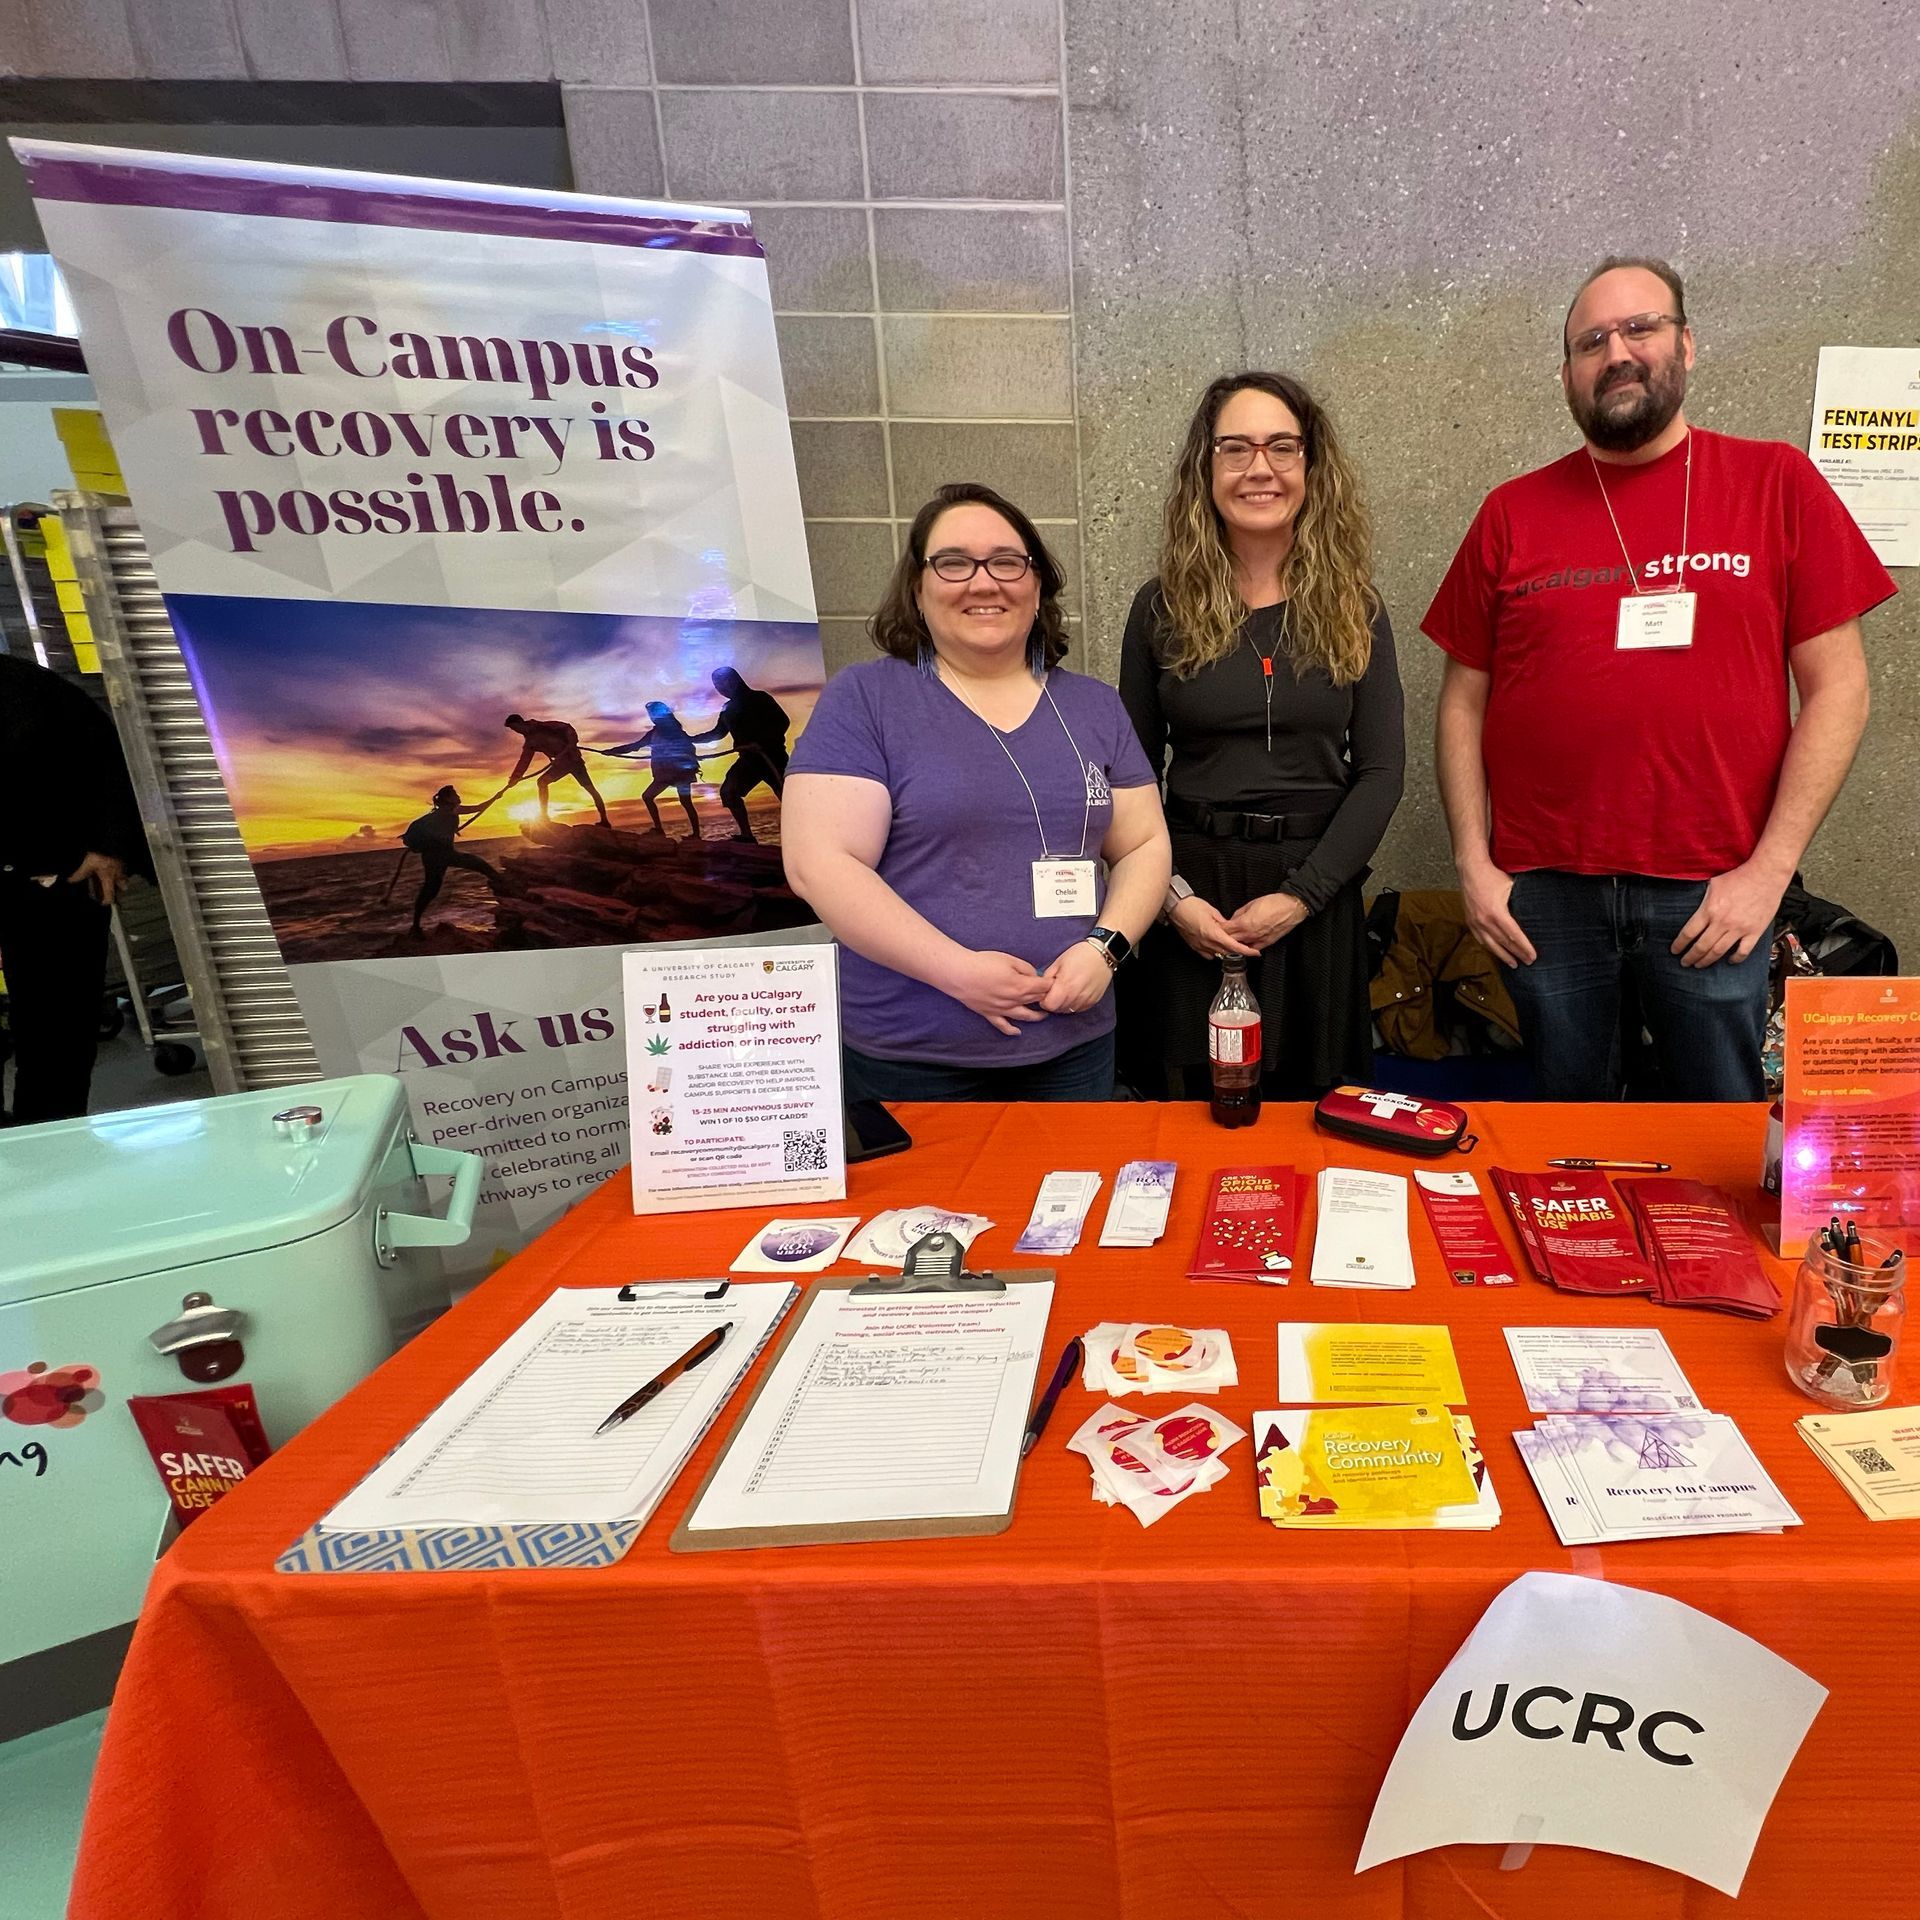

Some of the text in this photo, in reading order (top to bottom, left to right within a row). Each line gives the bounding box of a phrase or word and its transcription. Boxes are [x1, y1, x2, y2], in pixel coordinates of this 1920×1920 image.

[167, 307, 660, 401] On-Campus
[1823, 410, 1915, 427] FENTANYL
[189, 402, 655, 476] recovery is
[1822, 433, 1866, 449] TEST
[213, 472, 585, 552] possible.
[776, 964, 814, 972] CALGARY
[695, 994, 715, 1002] Are
[718, 994, 739, 1003] you
[751, 990, 802, 1001] UCalgary
[680, 1008, 728, 1019] student,
[731, 1007, 773, 1017] faculty,
[790, 1003, 816, 1013] staff
[1803, 1014, 1854, 1025] UCalgary
[1857, 1013, 1908, 1024] Recovery
[707, 1021, 795, 1034] struggling with
[393, 1008, 615, 1073] Ask us
[739, 1039, 751, 1047] or
[754, 1037, 765, 1045] in
[768, 1034, 822, 1046] recovery?
[424, 1071, 628, 1116] Recovery on Campus
[715, 1089, 750, 1097] SUPPORTS
[758, 1086, 793, 1094] DECREASE
[730, 1104, 781, 1113] ANONYMOUS
[783, 1102, 814, 1110] SURVEY
[1365, 1095, 1416, 1108] NALOXONE
[433, 1110, 546, 1144] peer-driven
[552, 1130, 570, 1143] to
[696, 1136, 745, 1144] PARTICIPATE:
[491, 1141, 621, 1178] celebrating all
[476, 1180, 548, 1206] thways
[553, 1173, 571, 1190] to
[1219, 1184, 1280, 1193] AWARE?
[1531, 1197, 1610, 1212] SAFER
[1535, 1210, 1615, 1222] CANNABIS
[1538, 1219, 1568, 1230] USE
[1324, 1439, 1411, 1454] Recovery
[161, 1453, 246, 1480] SAFER
[1328, 1451, 1442, 1469] Community
[1606, 1483, 1757, 1497] Recovery On Campus
[176, 1492, 214, 1509] USE
[1451, 1683, 1705, 1766] UCRC
